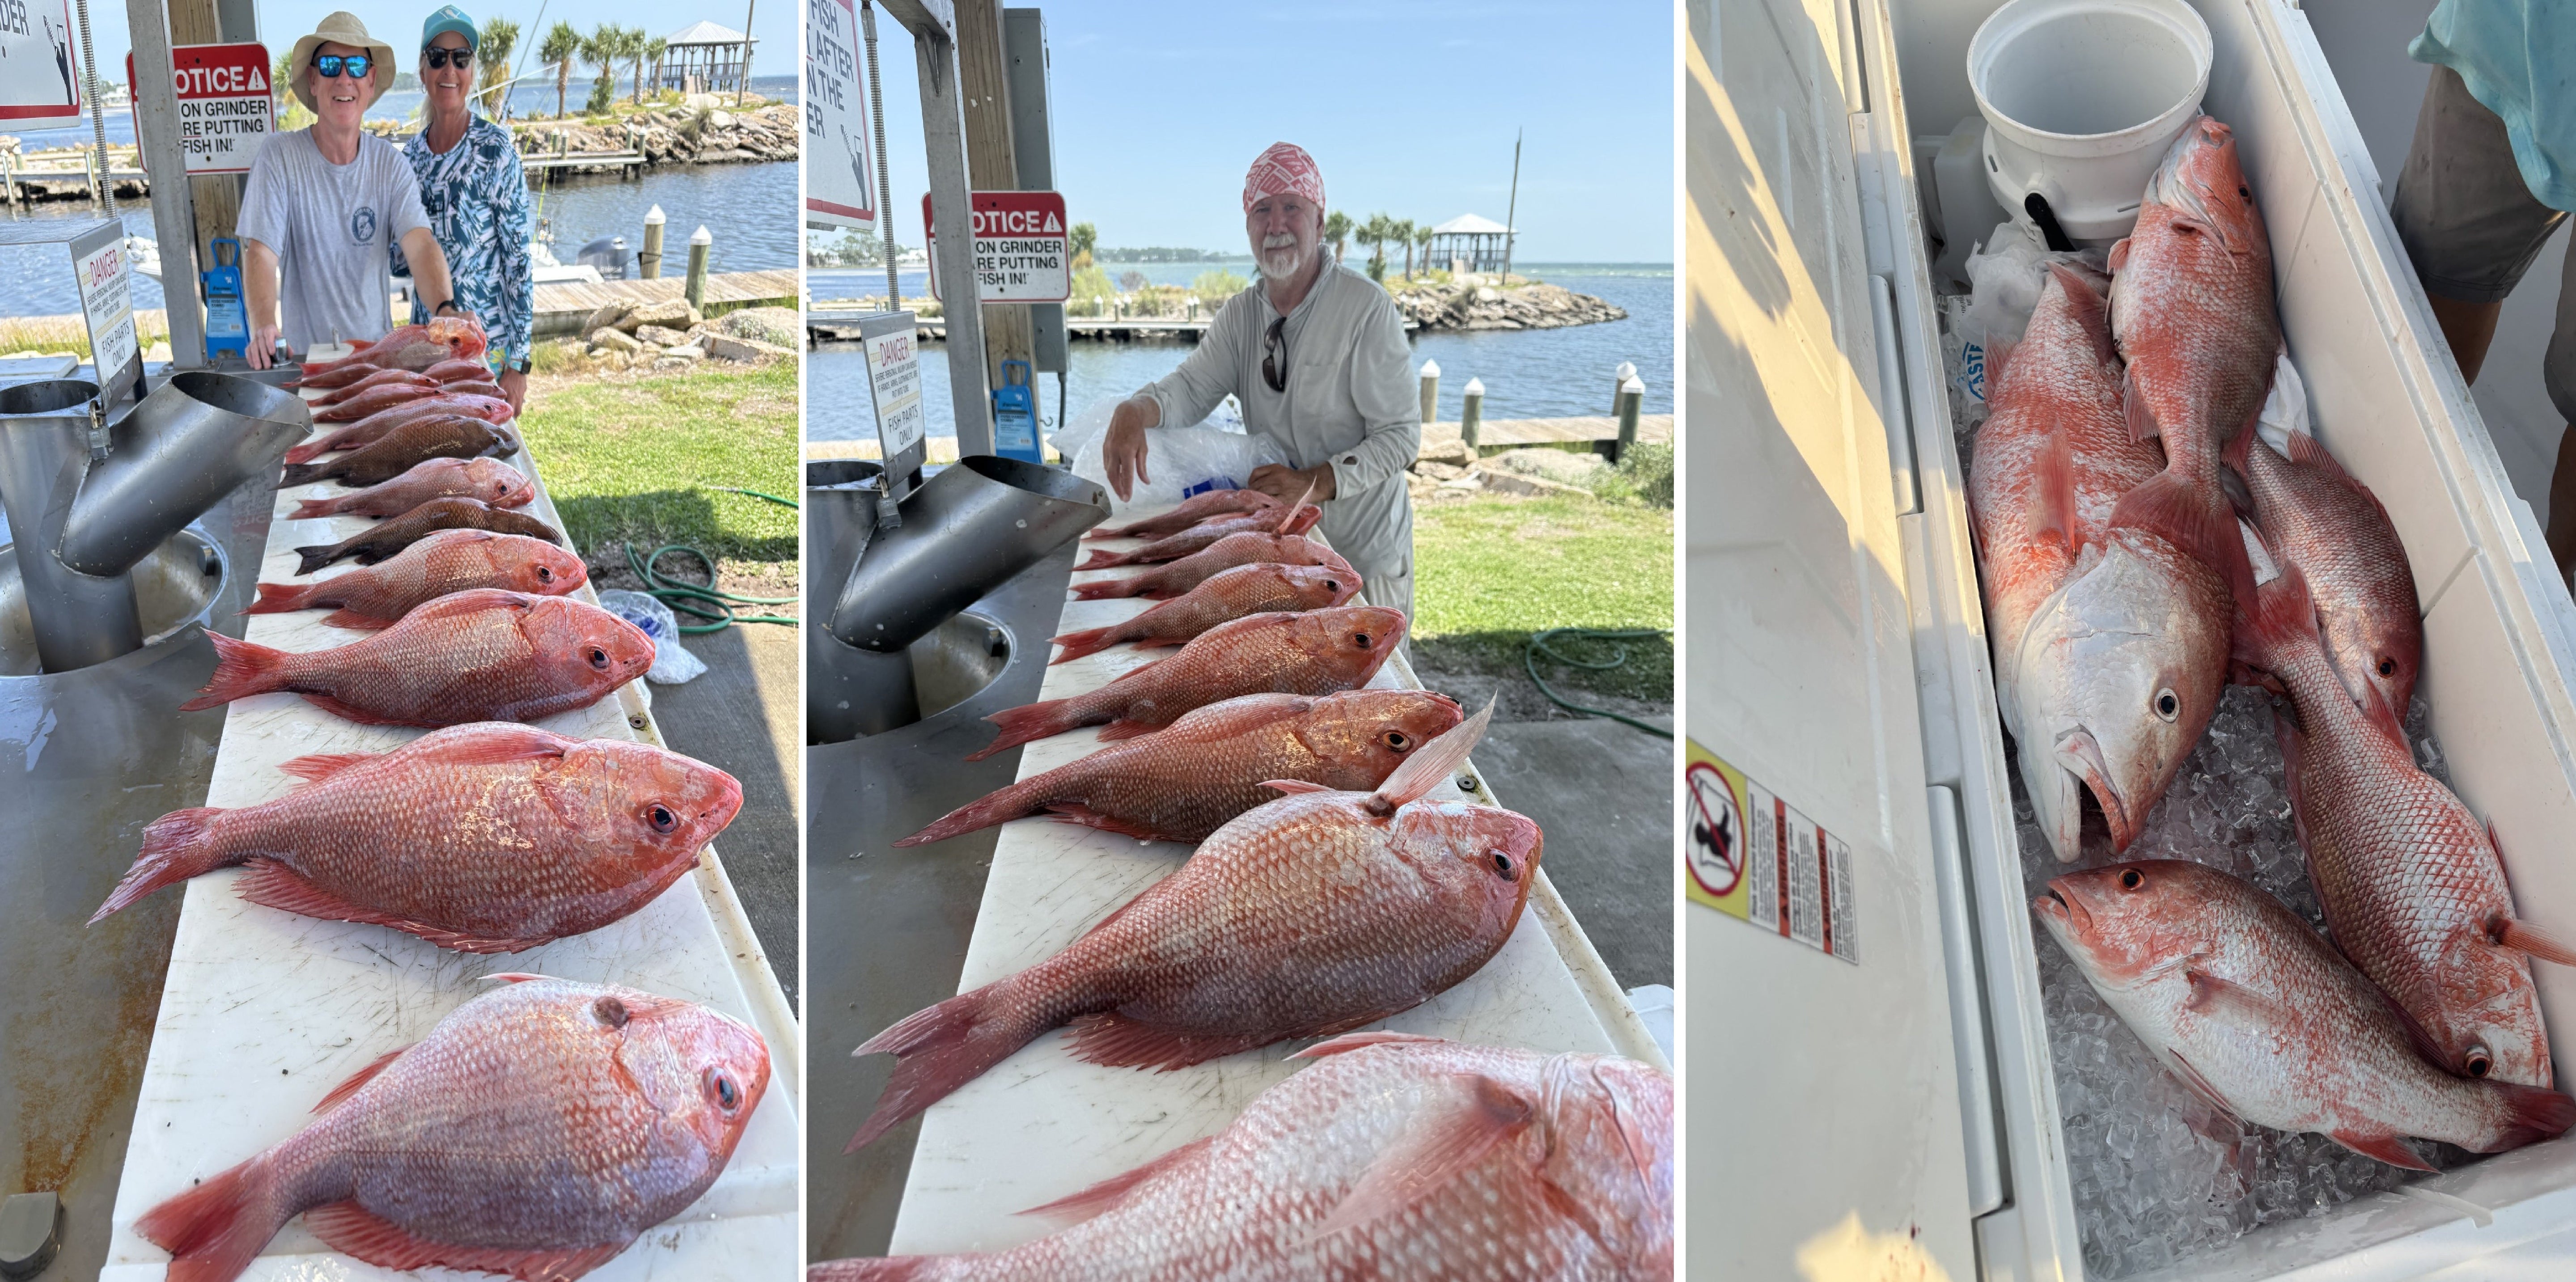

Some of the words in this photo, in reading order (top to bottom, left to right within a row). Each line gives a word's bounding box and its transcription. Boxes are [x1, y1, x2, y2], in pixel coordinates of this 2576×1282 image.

[0, 0, 30, 36] DER
[817, 30, 854, 83] AFTER
[175, 67, 245, 93] OTICE
[818, 68, 845, 112] THE
[181, 103, 201, 117] ON
[205, 100, 267, 116] GRINDER
[205, 118, 263, 134] PUTTING
[216, 138, 233, 152] IN!
[974, 211, 1041, 233] OTICE
[976, 241, 996, 254] ON
[1000, 241, 1062, 254] GRINDER
[90, 250, 119, 287] DANGER
[1000, 257, 1058, 269] PUTTING
[1010, 272, 1027, 285] IN!
[102, 333, 115, 356] FISH
[115, 321, 130, 346] PARTS
[113, 343, 126, 366] ONLY
[880, 337, 910, 367] DANGER
[888, 413, 902, 433] FISH
[902, 404, 918, 425] PARTS
[899, 425, 913, 445] ONLY
